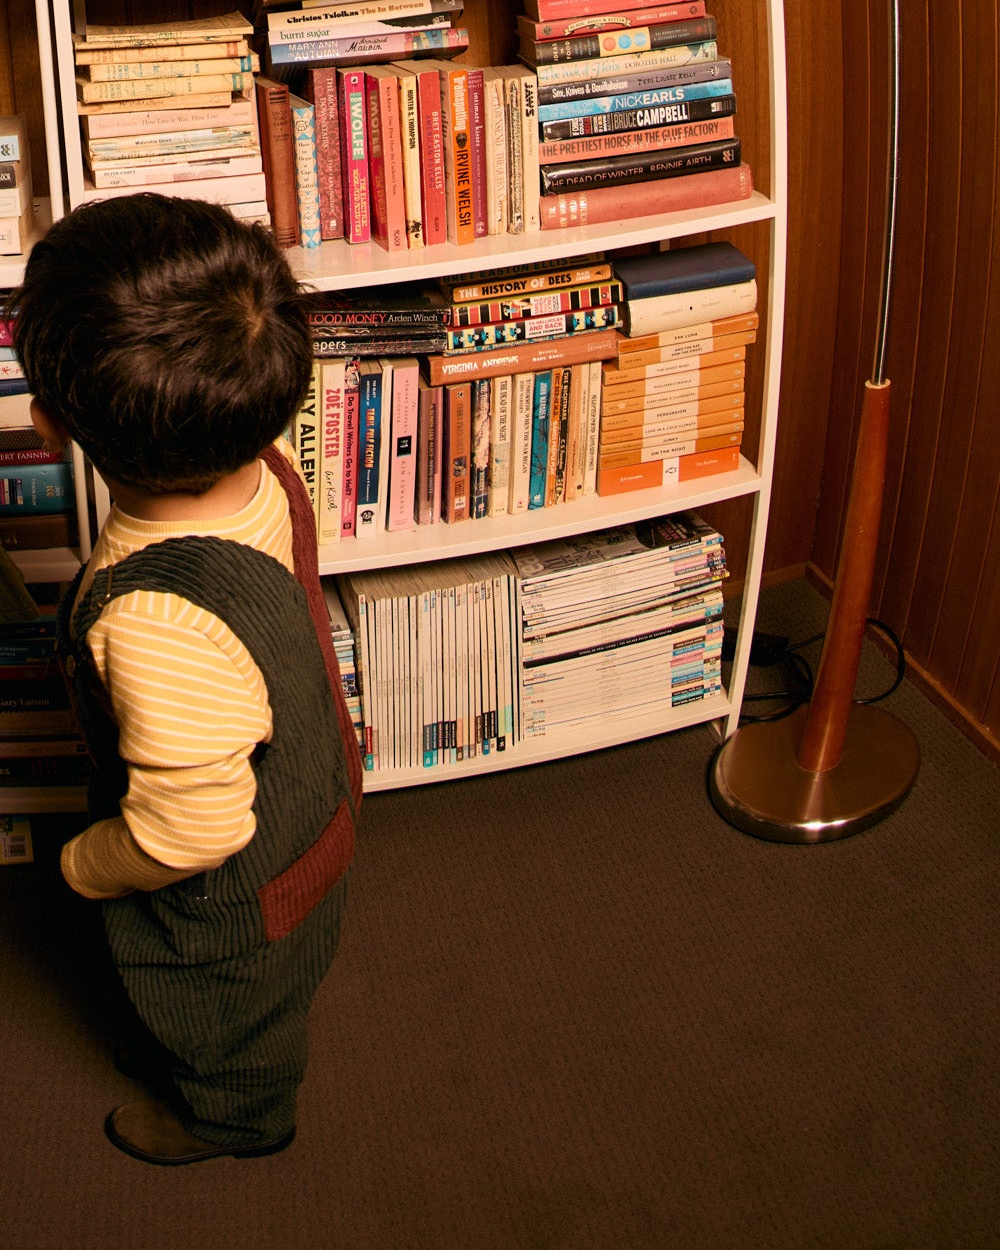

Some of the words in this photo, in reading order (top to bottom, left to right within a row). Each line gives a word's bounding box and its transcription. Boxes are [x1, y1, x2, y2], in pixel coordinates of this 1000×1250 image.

[452, 75, 466, 130] Trainspotting
[524, 82, 535, 117] JAWS
[614, 110, 636, 129] BRUCE
[636, 104, 688, 126] CAMPBELL
[456, 150, 470, 185] IRVINE
[458, 188, 471, 226] WELSH
[459, 288, 478, 297] THE
[481, 281, 527, 296] HISTORY
[531, 278, 544, 288] OF
[548, 274, 572, 285] BEES
[310, 314, 342, 324] LOOD
[346, 312, 387, 324] MONEY
[388, 314, 412, 322] Arden
[413, 313, 438, 322] Winch
[442, 361, 478, 374] VIRGINIA
[482, 356, 518, 367] ANDREWS
[326, 388, 341, 408] ZOË
[324, 410, 340, 458] FOSTER
